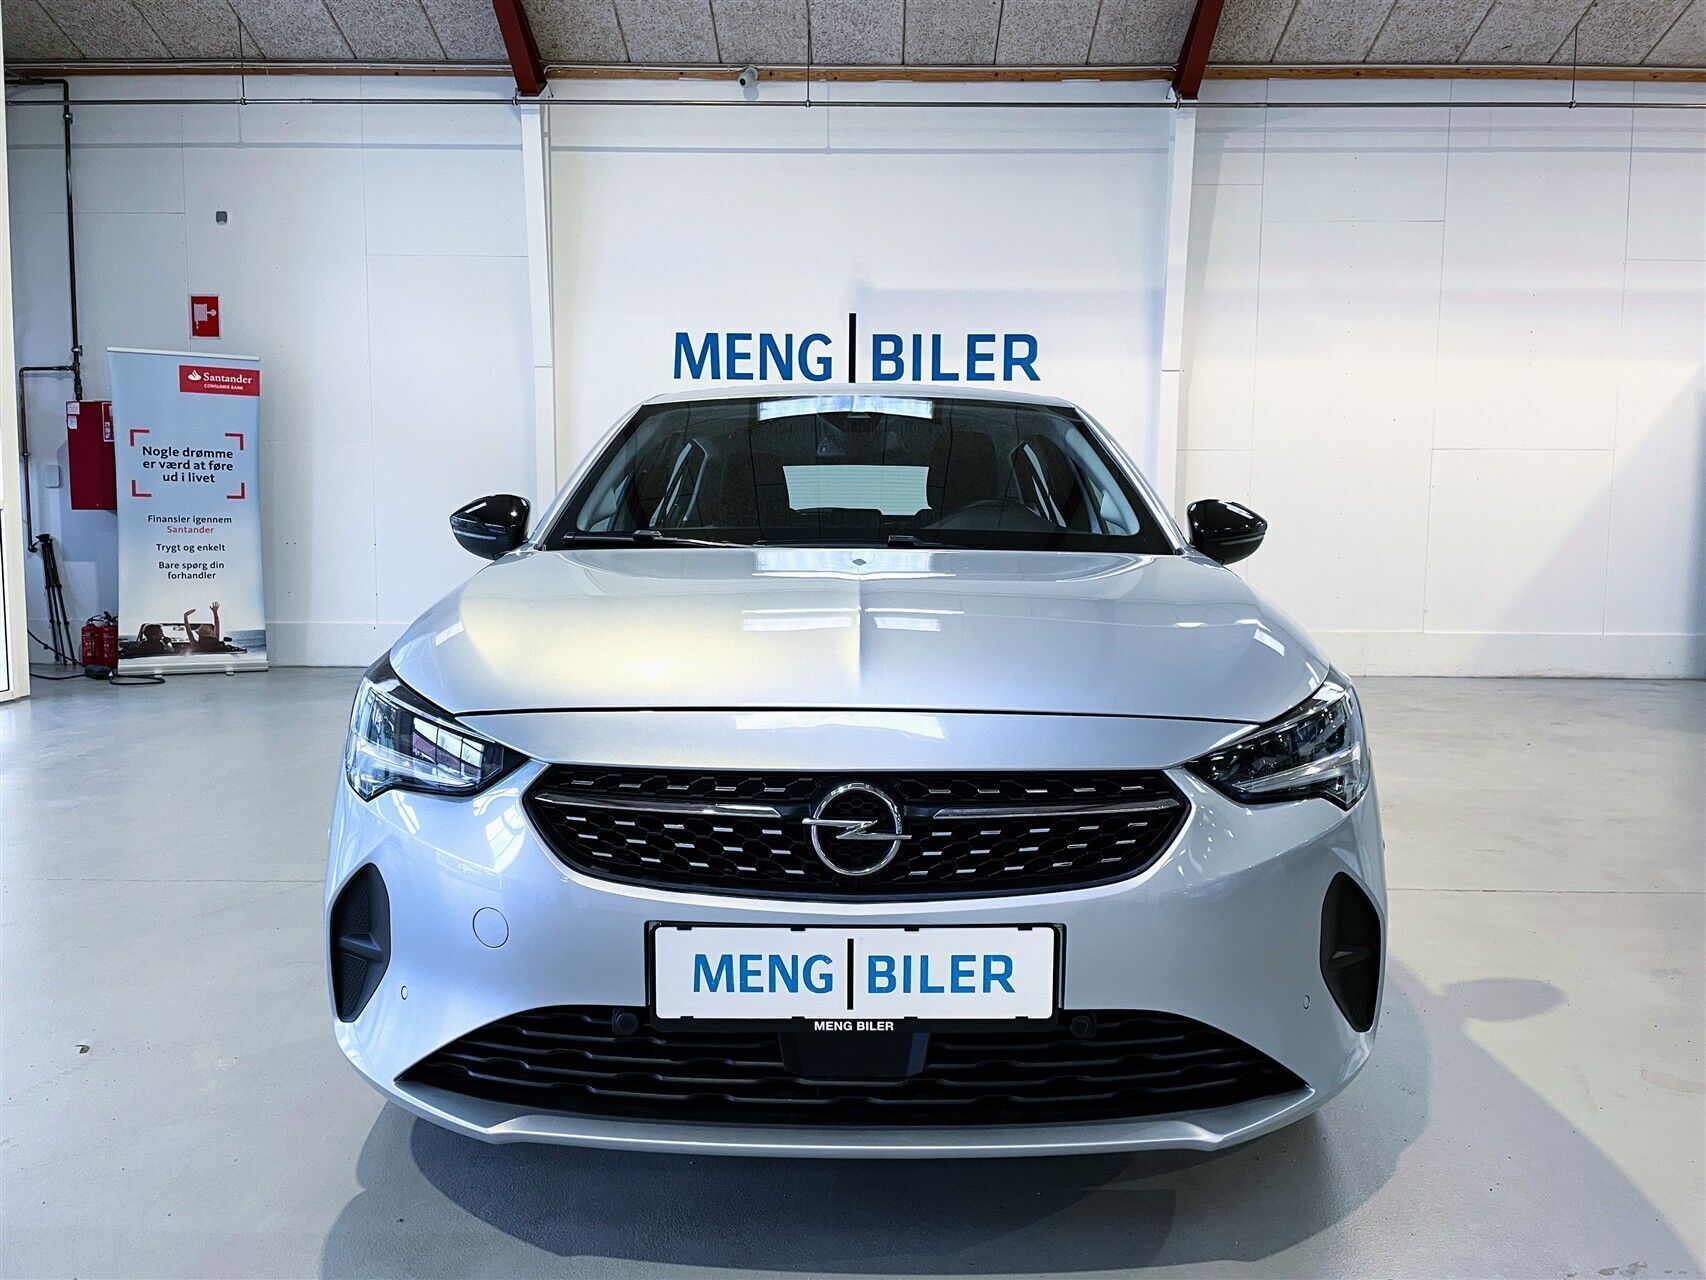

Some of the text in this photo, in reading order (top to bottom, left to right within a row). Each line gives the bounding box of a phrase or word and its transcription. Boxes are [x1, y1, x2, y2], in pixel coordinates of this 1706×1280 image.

[673, 332, 1042, 382] MENG BILER
[203, 372, 252, 384] Santander
[142, 446, 234, 459] Nogle drømme
[142, 459, 234, 471] er værd at føre
[162, 472, 178, 482] ud
[188, 472, 216, 483] livet
[147, 514, 232, 525] Finansier igennem
[166, 525, 214, 534] Santander
[156, 543, 226, 553] Trygt og enkelt
[158, 561, 225, 571] Bare spørg din
[167, 571, 217, 580] forhandler
[693, 953, 1016, 994] MENG BILER
[814, 1021, 894, 1032] MENG BILER
